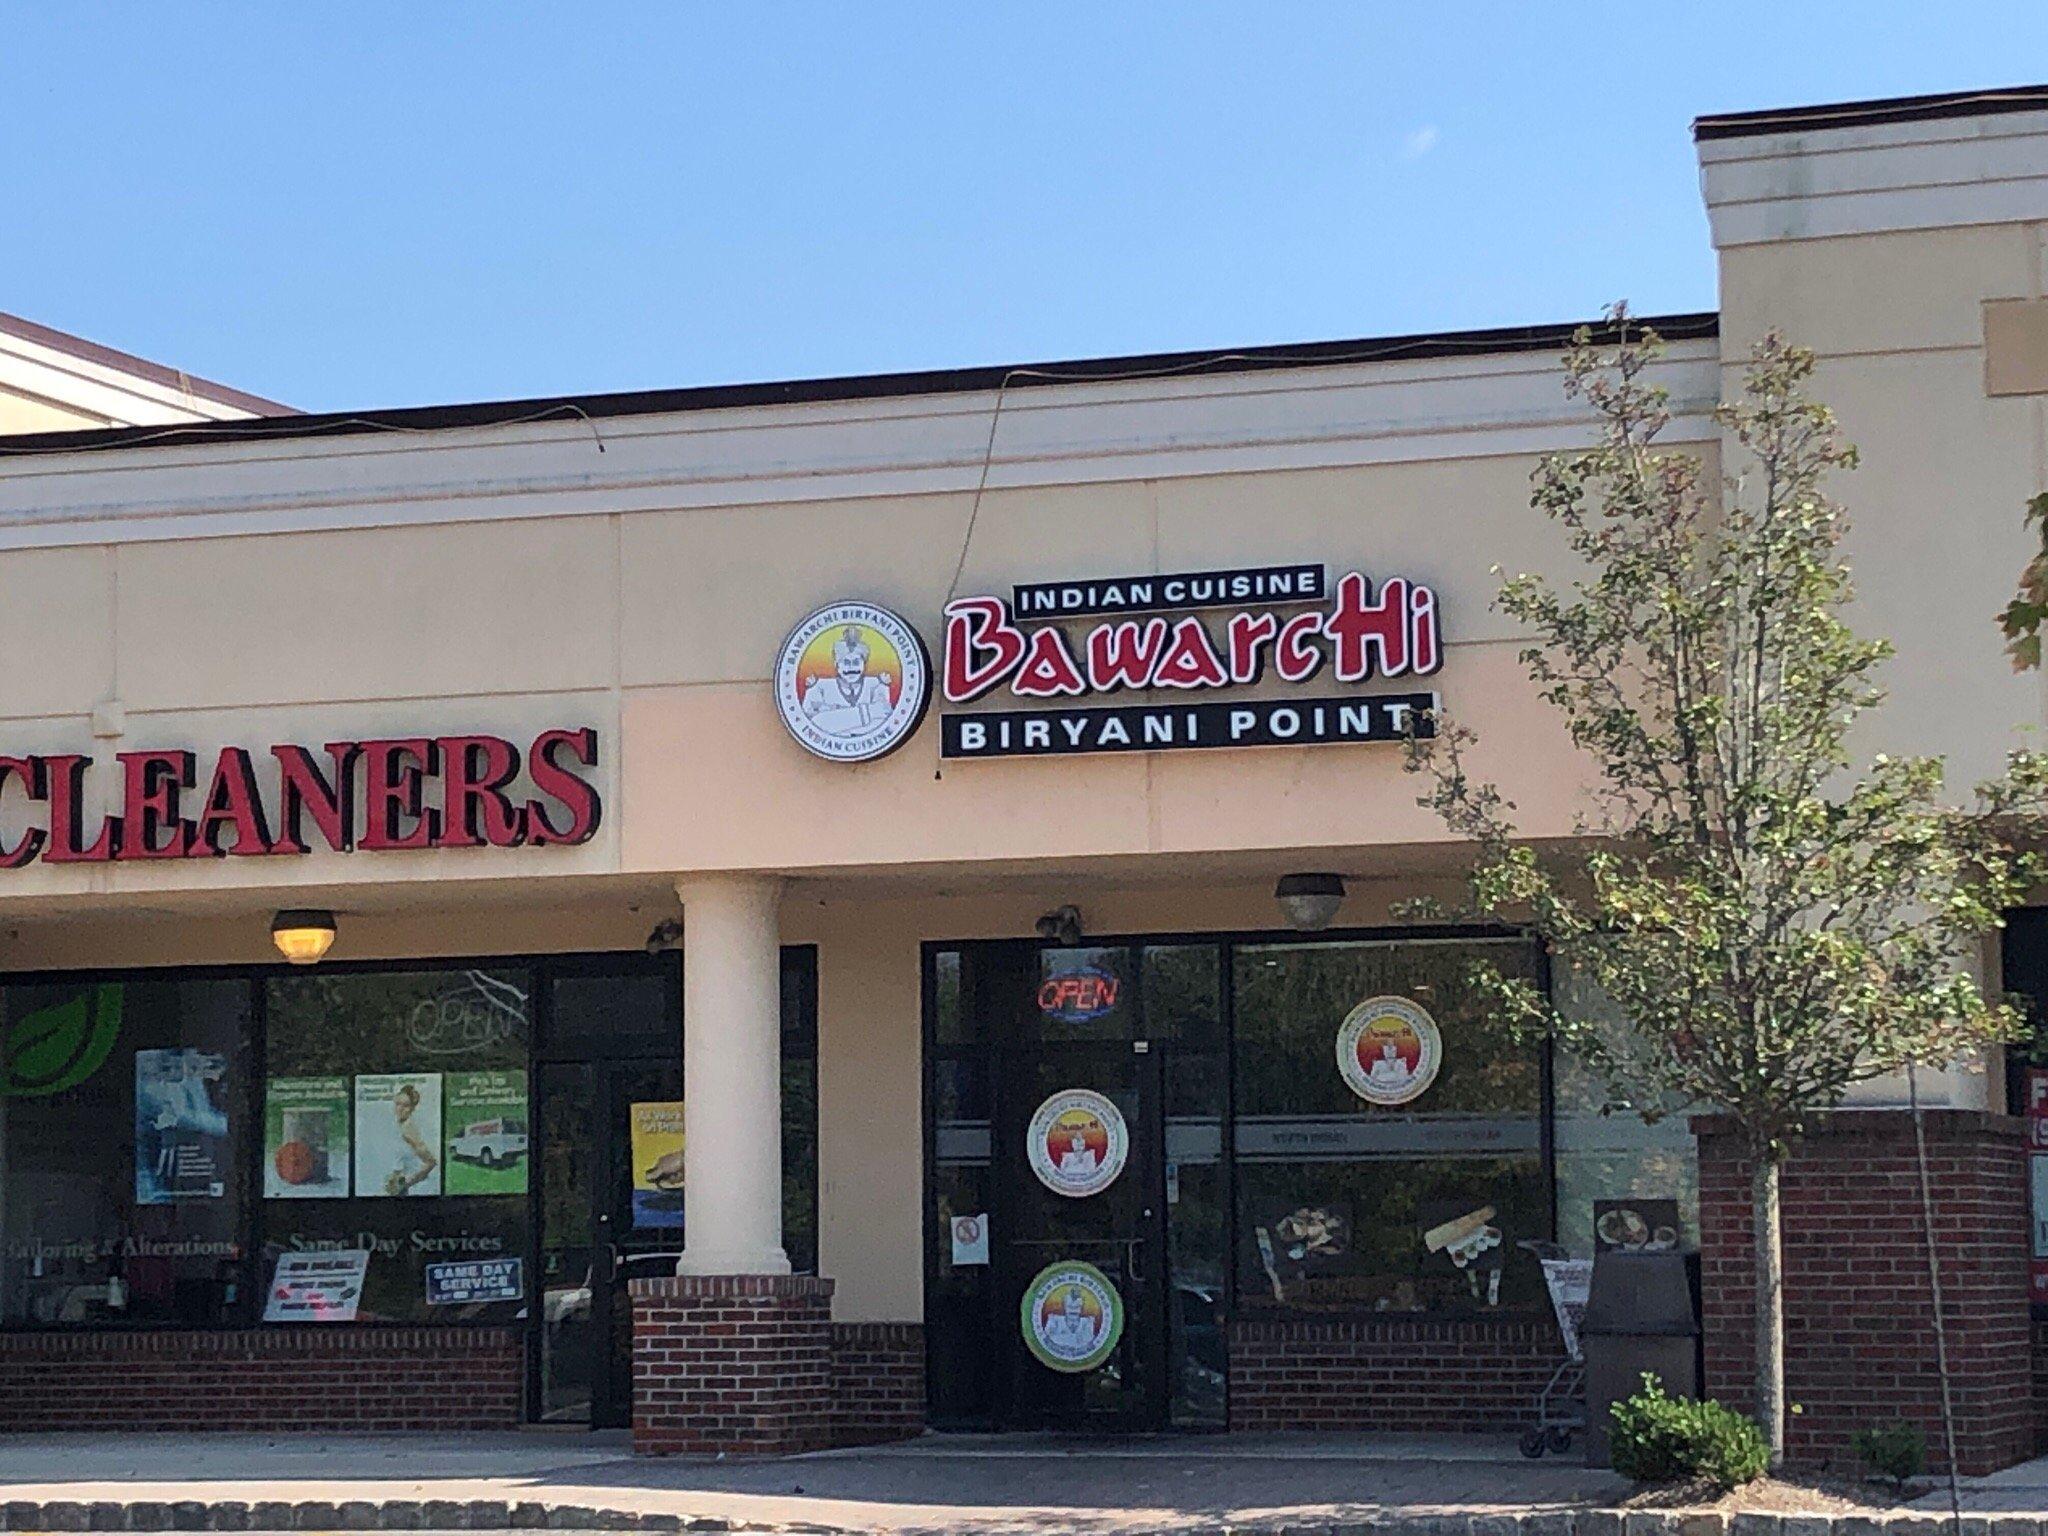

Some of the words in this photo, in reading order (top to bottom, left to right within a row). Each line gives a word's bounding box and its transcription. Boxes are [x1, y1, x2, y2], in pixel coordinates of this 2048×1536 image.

[1020, 582, 1153, 612] INDIAN
[1164, 571, 1317, 602] CUISINE
[787, 612, 840, 666] BAWARCHI
[842, 609, 892, 632] BIRYANI
[892, 630, 917, 667] POINT
[801, 724, 843, 751] INDIAN
[844, 726, 892, 752] CUISINE
[960, 712, 1198, 750] BIRYANI
[1230, 702, 1411, 740] POINT
[0, 728, 602, 869] CLEANERS
[1037, 977, 1120, 1011] OPEN
[410, 998, 514, 1042] OPEN
[120, 1233, 238, 1257] Alterations
[357, 1231, 402, 1258] Day
[410, 1229, 503, 1251] Services
[433, 1265, 479, 1279] SAME
[482, 1263, 514, 1276] DAY
[440, 1275, 508, 1291] SERVICE
